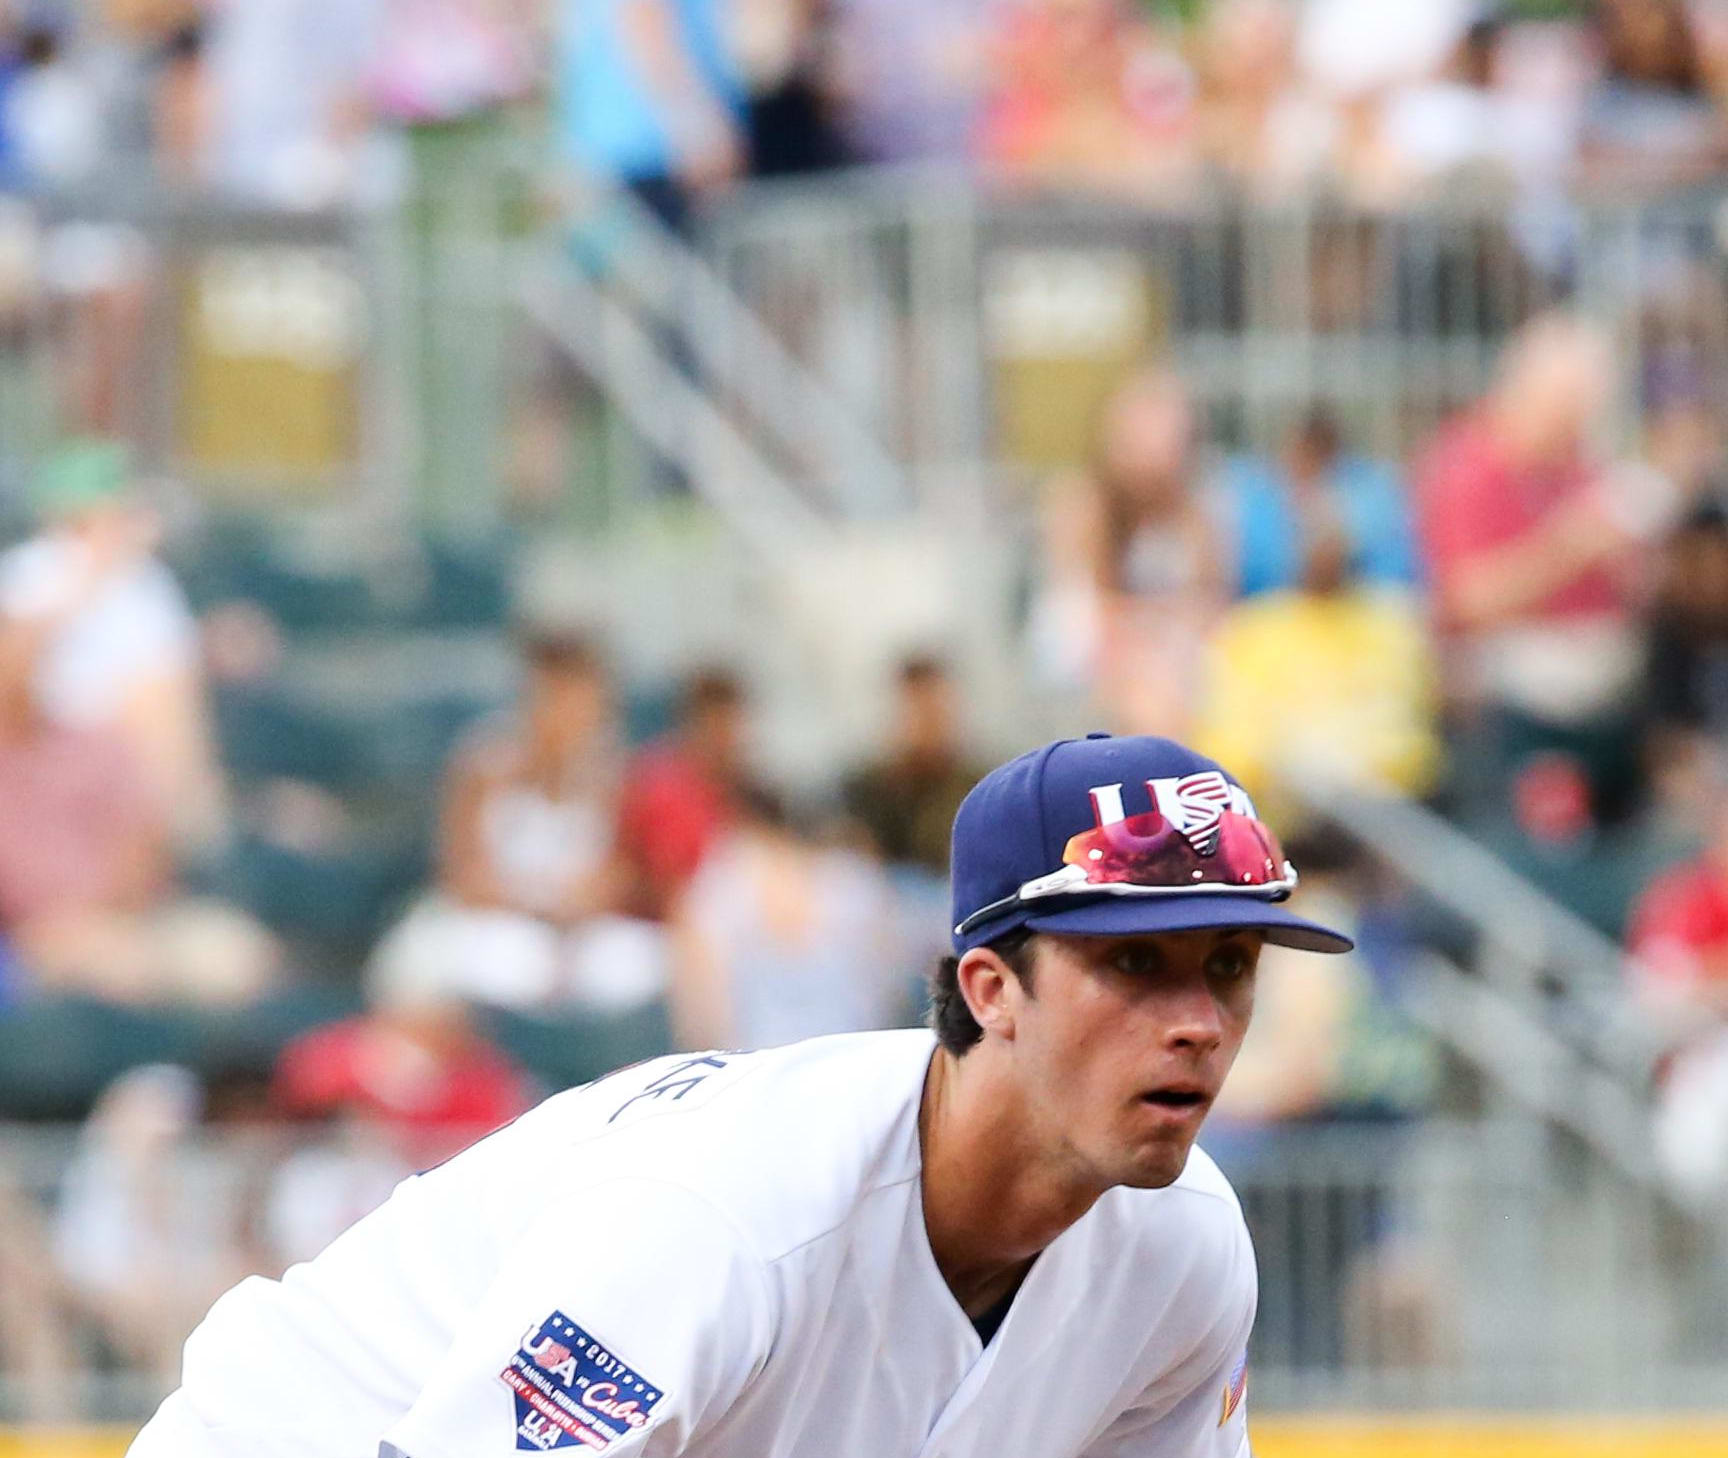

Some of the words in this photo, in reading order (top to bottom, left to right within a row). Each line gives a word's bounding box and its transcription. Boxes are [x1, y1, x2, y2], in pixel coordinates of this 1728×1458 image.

[521, 1326, 578, 1388] USA
[582, 1382, 647, 1428] Cuba
[584, 1344, 626, 1379] 2017
